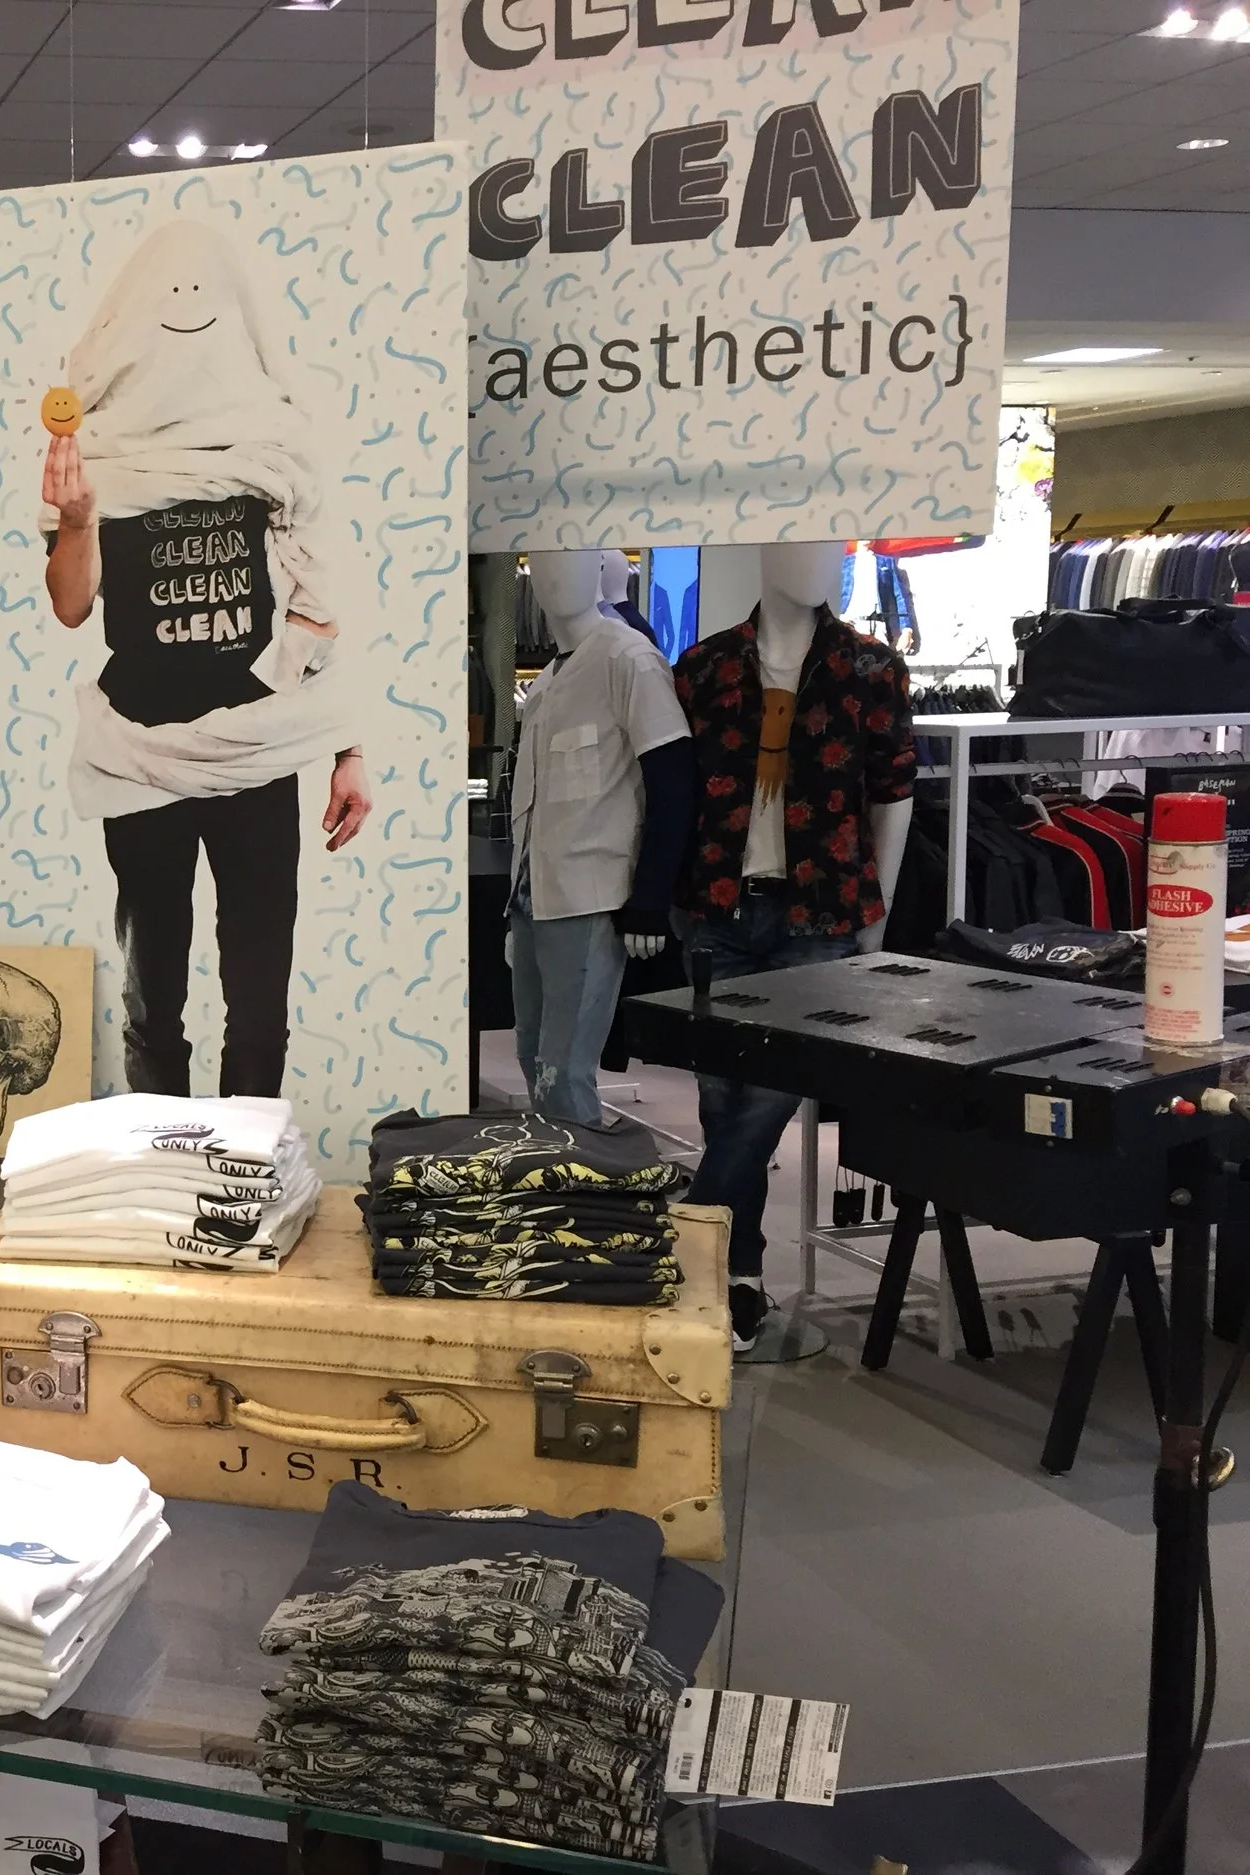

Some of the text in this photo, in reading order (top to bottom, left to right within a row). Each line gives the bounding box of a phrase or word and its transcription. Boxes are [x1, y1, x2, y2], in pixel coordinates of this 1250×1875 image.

[462, 0, 951, 70] CLE
[468, 83, 982, 261] CLEAN
[468, 294, 974, 418] aesthetic}
[151, 530, 250, 568] CLEAN
[150, 567, 251, 606] CLEAN
[156, 606, 252, 643] CLEAN
[1152, 888, 1191, 901] FLASH
[162, 1139, 201, 1151] ONLY
[219, 1161, 262, 1177] ONLY
[235, 1186, 274, 1200] ONLY
[210, 1206, 251, 1220] ONLY
[177, 1236, 218, 1257] ONLY
[27, 1839, 77, 1857] LOCALS
